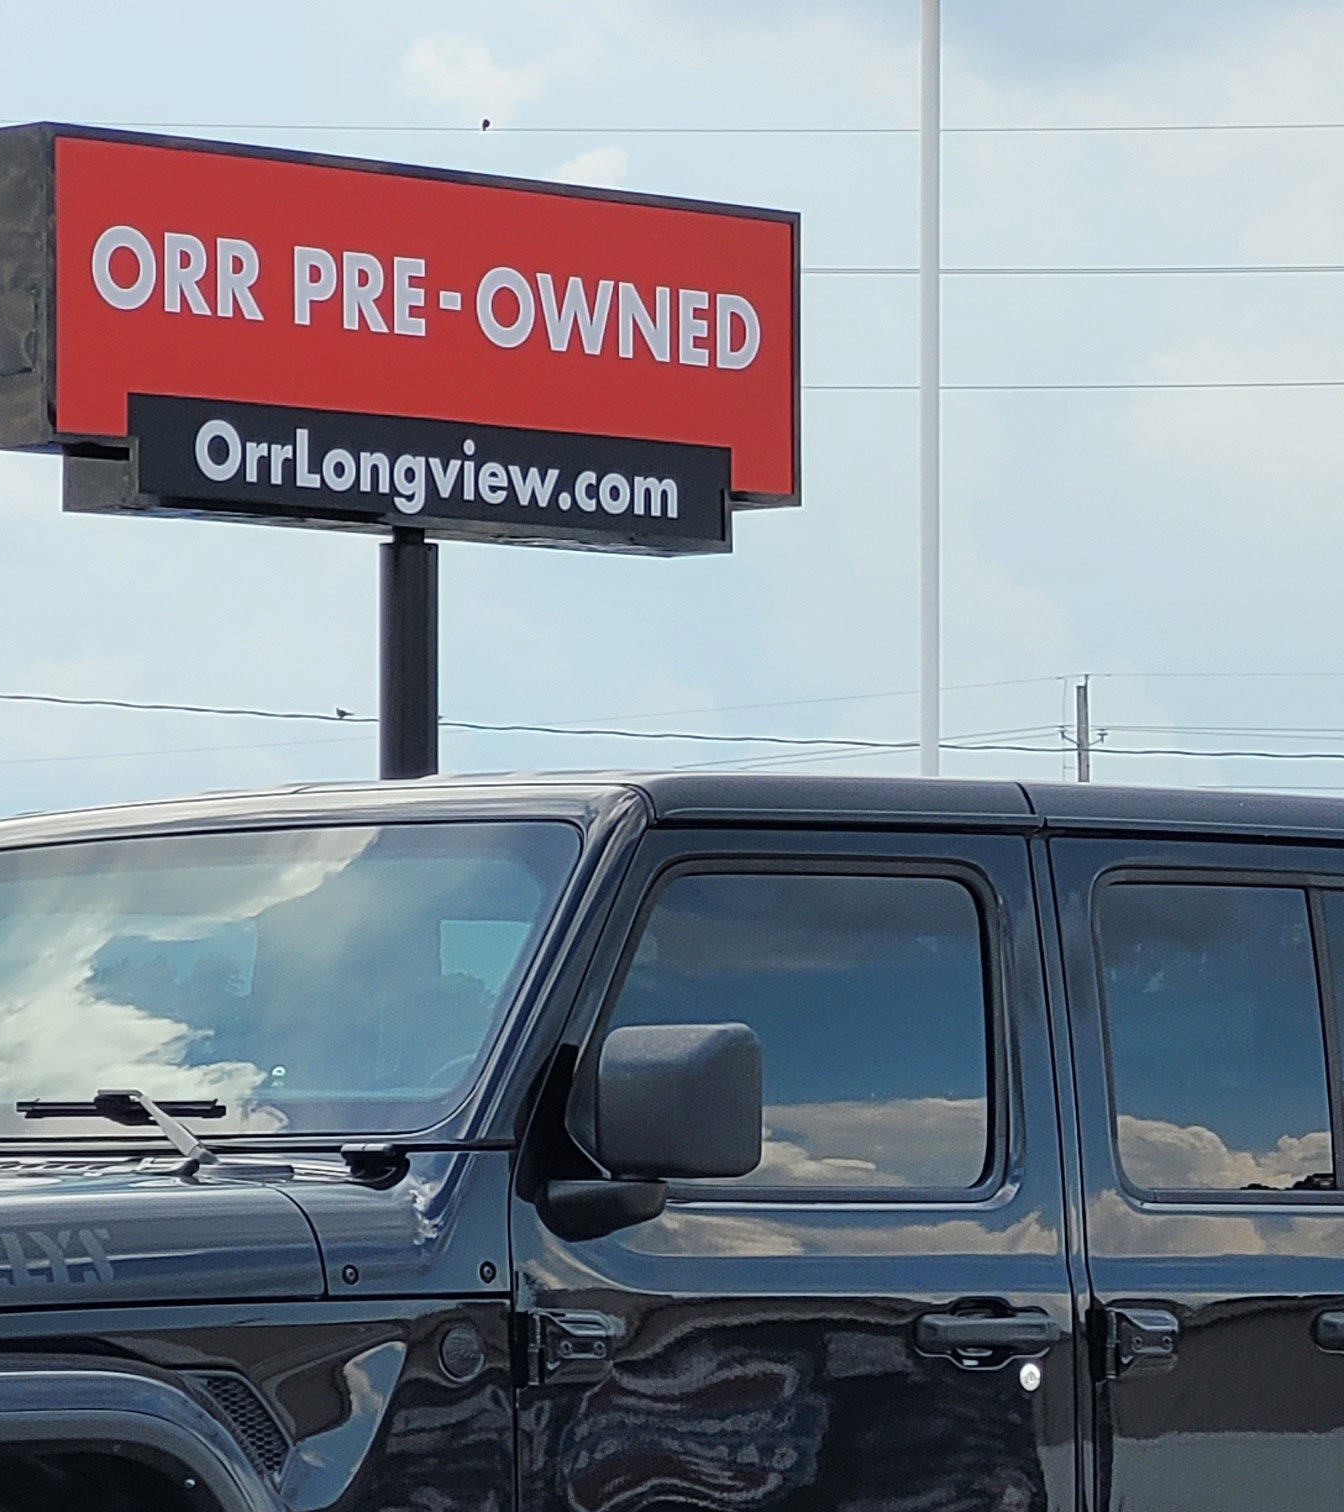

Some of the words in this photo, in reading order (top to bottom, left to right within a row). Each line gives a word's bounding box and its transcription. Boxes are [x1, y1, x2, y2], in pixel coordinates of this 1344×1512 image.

[90, 224, 265, 322] ORR
[293, 244, 762, 371] PRE-OWNED
[193, 418, 679, 520] OrrLongview.com
